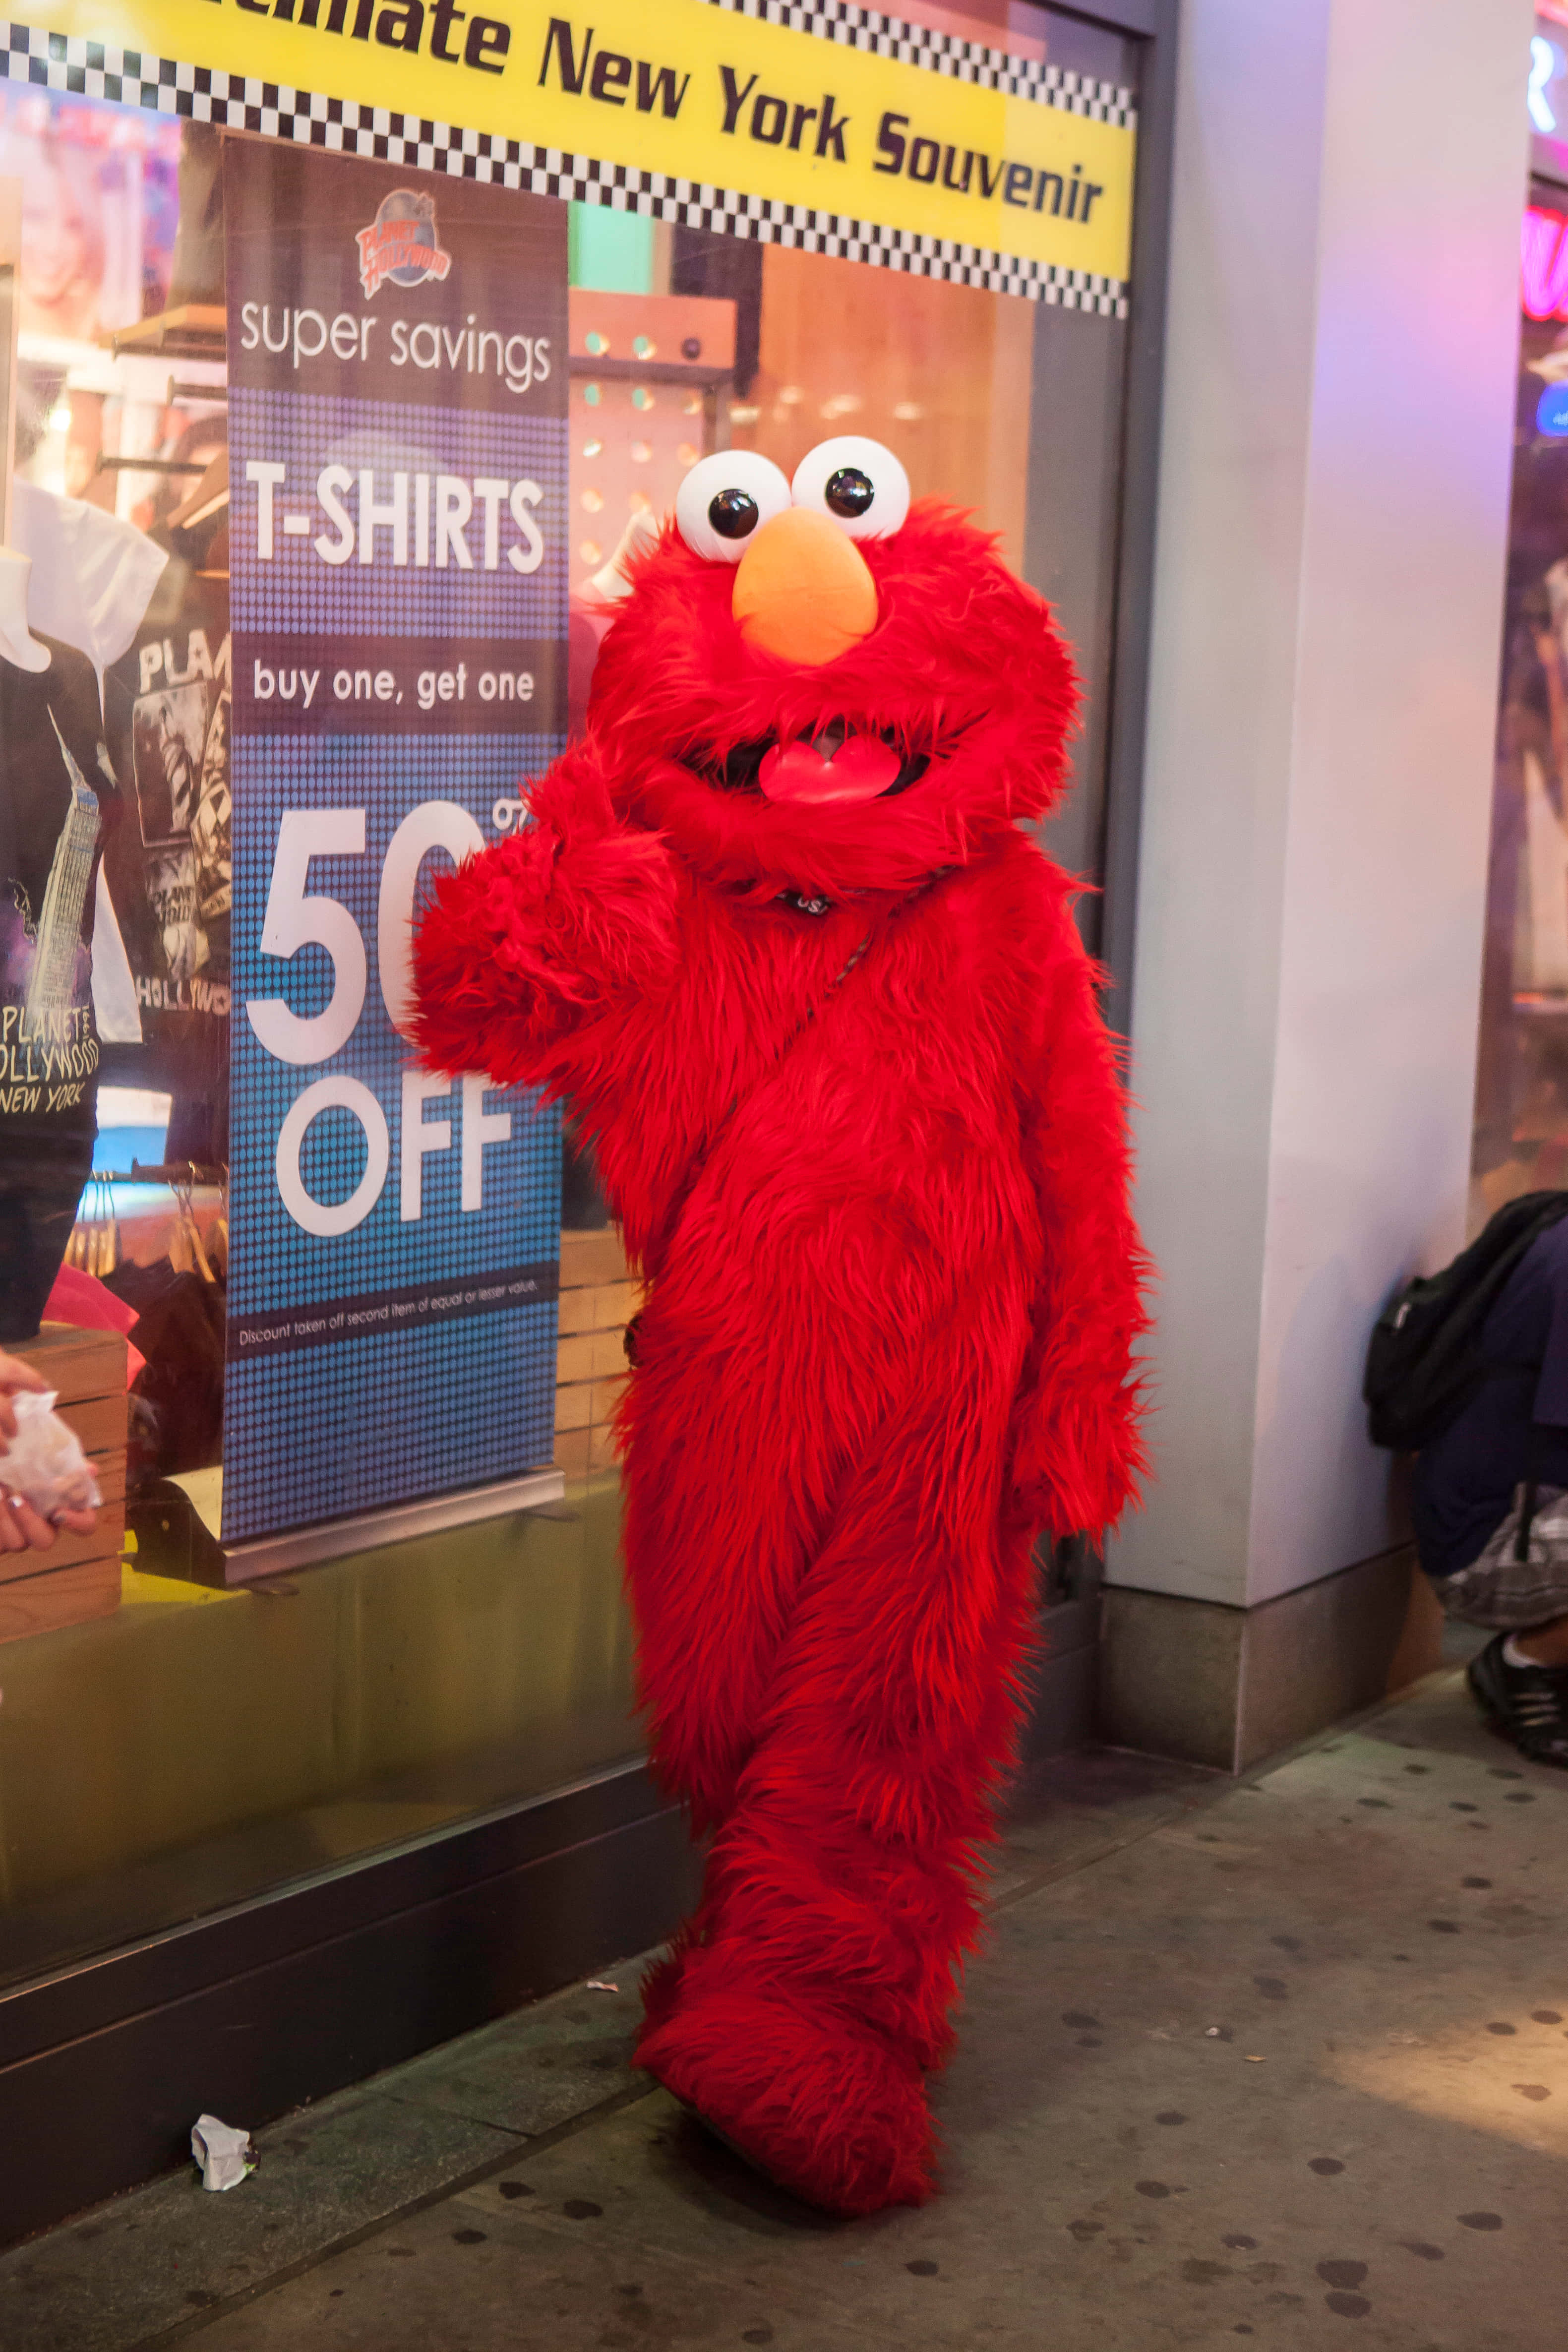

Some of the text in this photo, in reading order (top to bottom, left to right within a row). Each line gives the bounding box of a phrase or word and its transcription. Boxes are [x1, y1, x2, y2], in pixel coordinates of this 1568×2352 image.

[538, 17, 691, 121] New
[718, 64, 850, 164] York
[872, 110, 1104, 225] Souvenir
[240, 302, 551, 393] super savings
[246, 461, 544, 574] T-SHIRTS
[253, 659, 535, 710] buy one, get one
[2, 1005, 81, 1043] PLANET
[0, 1081, 86, 1114] NEW YORK
[276, 1070, 511, 1237] OFF
[239, 1322, 290, 1346] Discount
[294, 1319, 326, 1335] taken
[329, 1312, 344, 1329] off
[347, 1305, 389, 1327] second
[391, 1302, 416, 1318] item
[418, 1296, 428, 1313] of
[431, 1291, 463, 1310] equal
[465, 1291, 476, 1304] or
